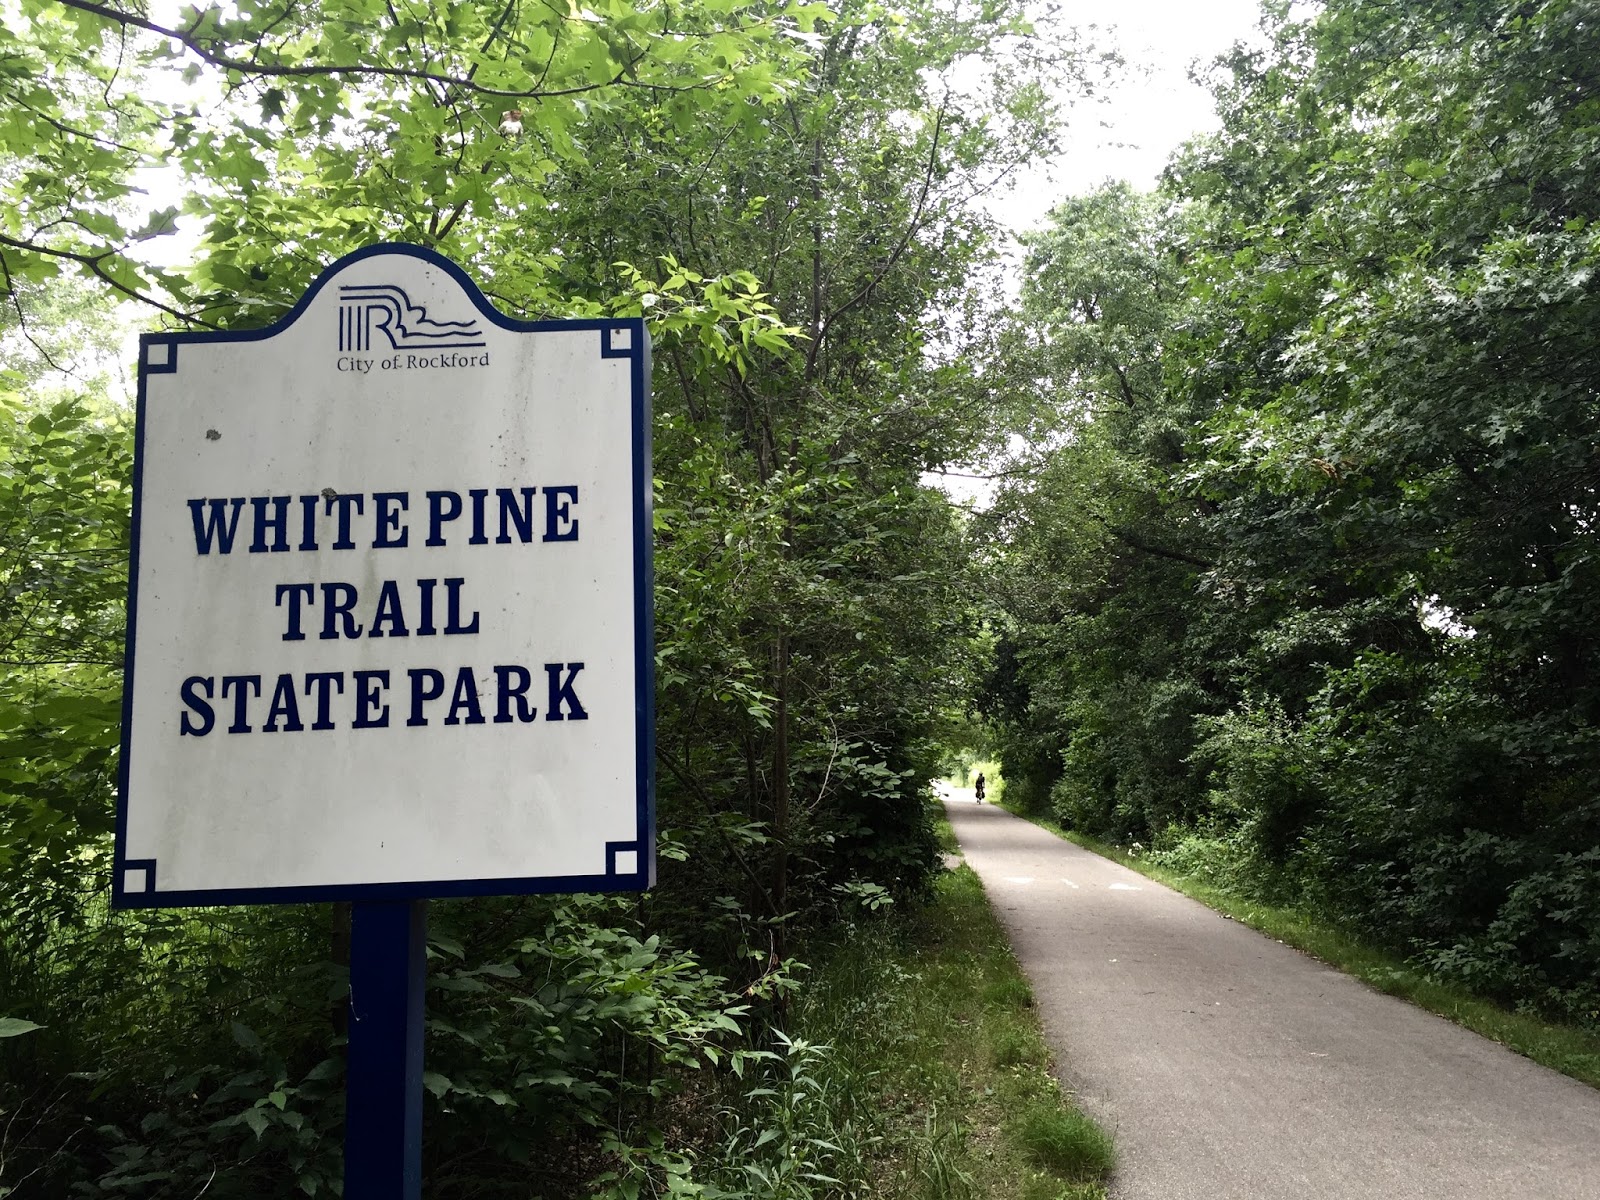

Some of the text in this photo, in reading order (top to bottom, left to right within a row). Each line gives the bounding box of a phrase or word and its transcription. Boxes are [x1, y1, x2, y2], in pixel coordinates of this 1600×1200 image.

[337, 352, 489, 374] City of Rockford
[186, 485, 579, 556] WHITE PINE
[275, 577, 480, 642] TRAIL
[179, 662, 589, 738] STATE PARK
